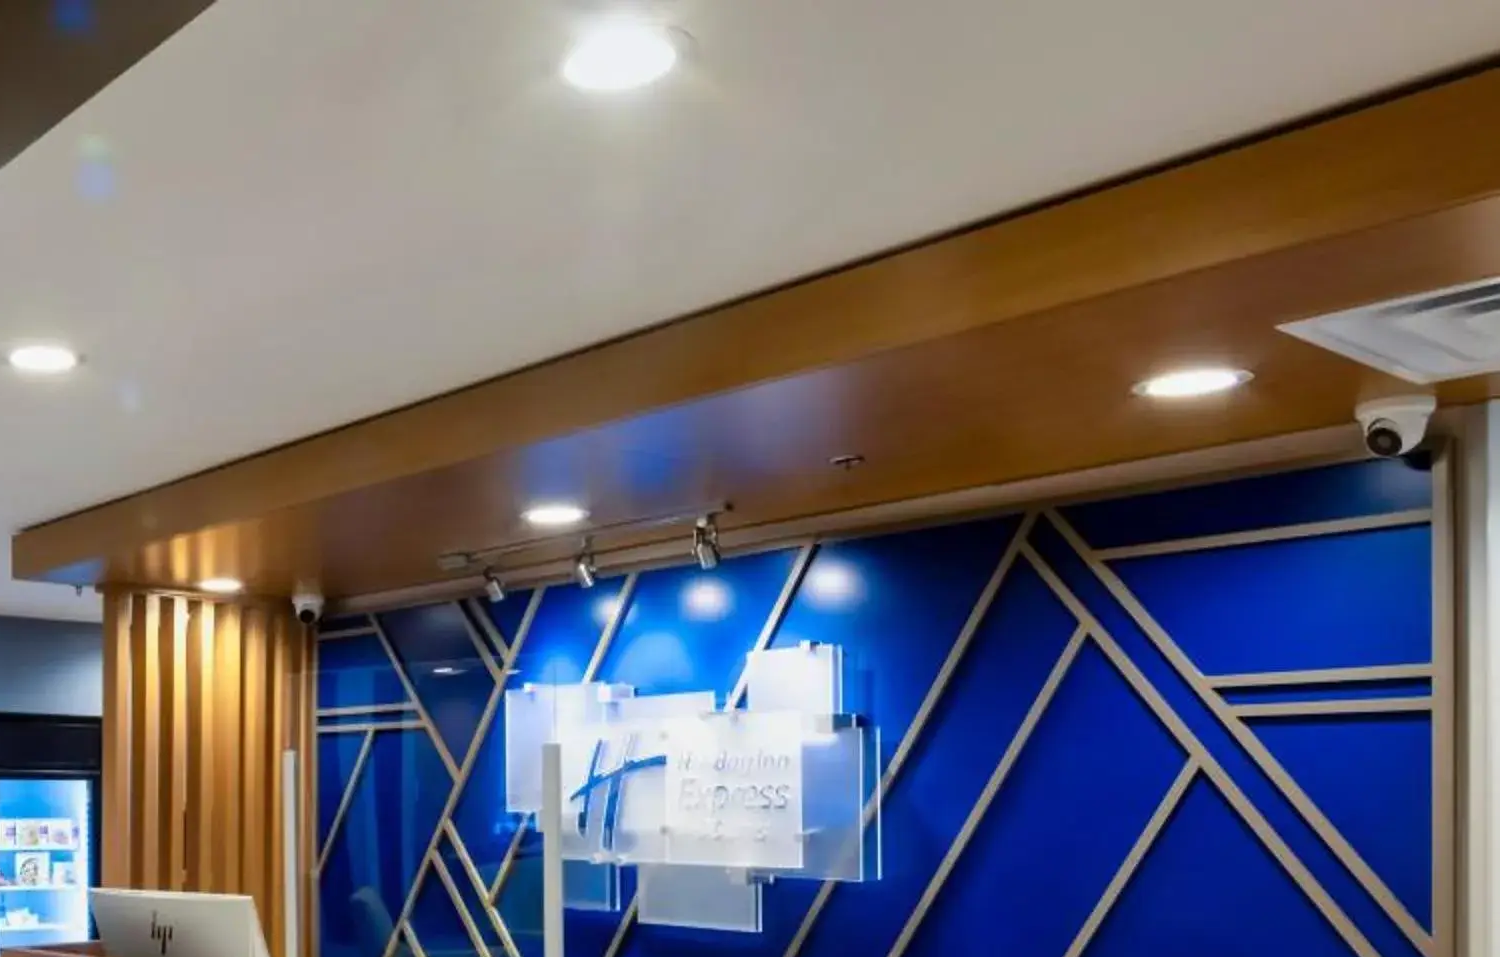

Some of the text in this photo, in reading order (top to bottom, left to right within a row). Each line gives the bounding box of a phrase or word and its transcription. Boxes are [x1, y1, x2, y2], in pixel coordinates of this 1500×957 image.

[677, 748, 753, 778] Hday
[679, 777, 792, 816] Express
[150, 909, 173, 956] hp
